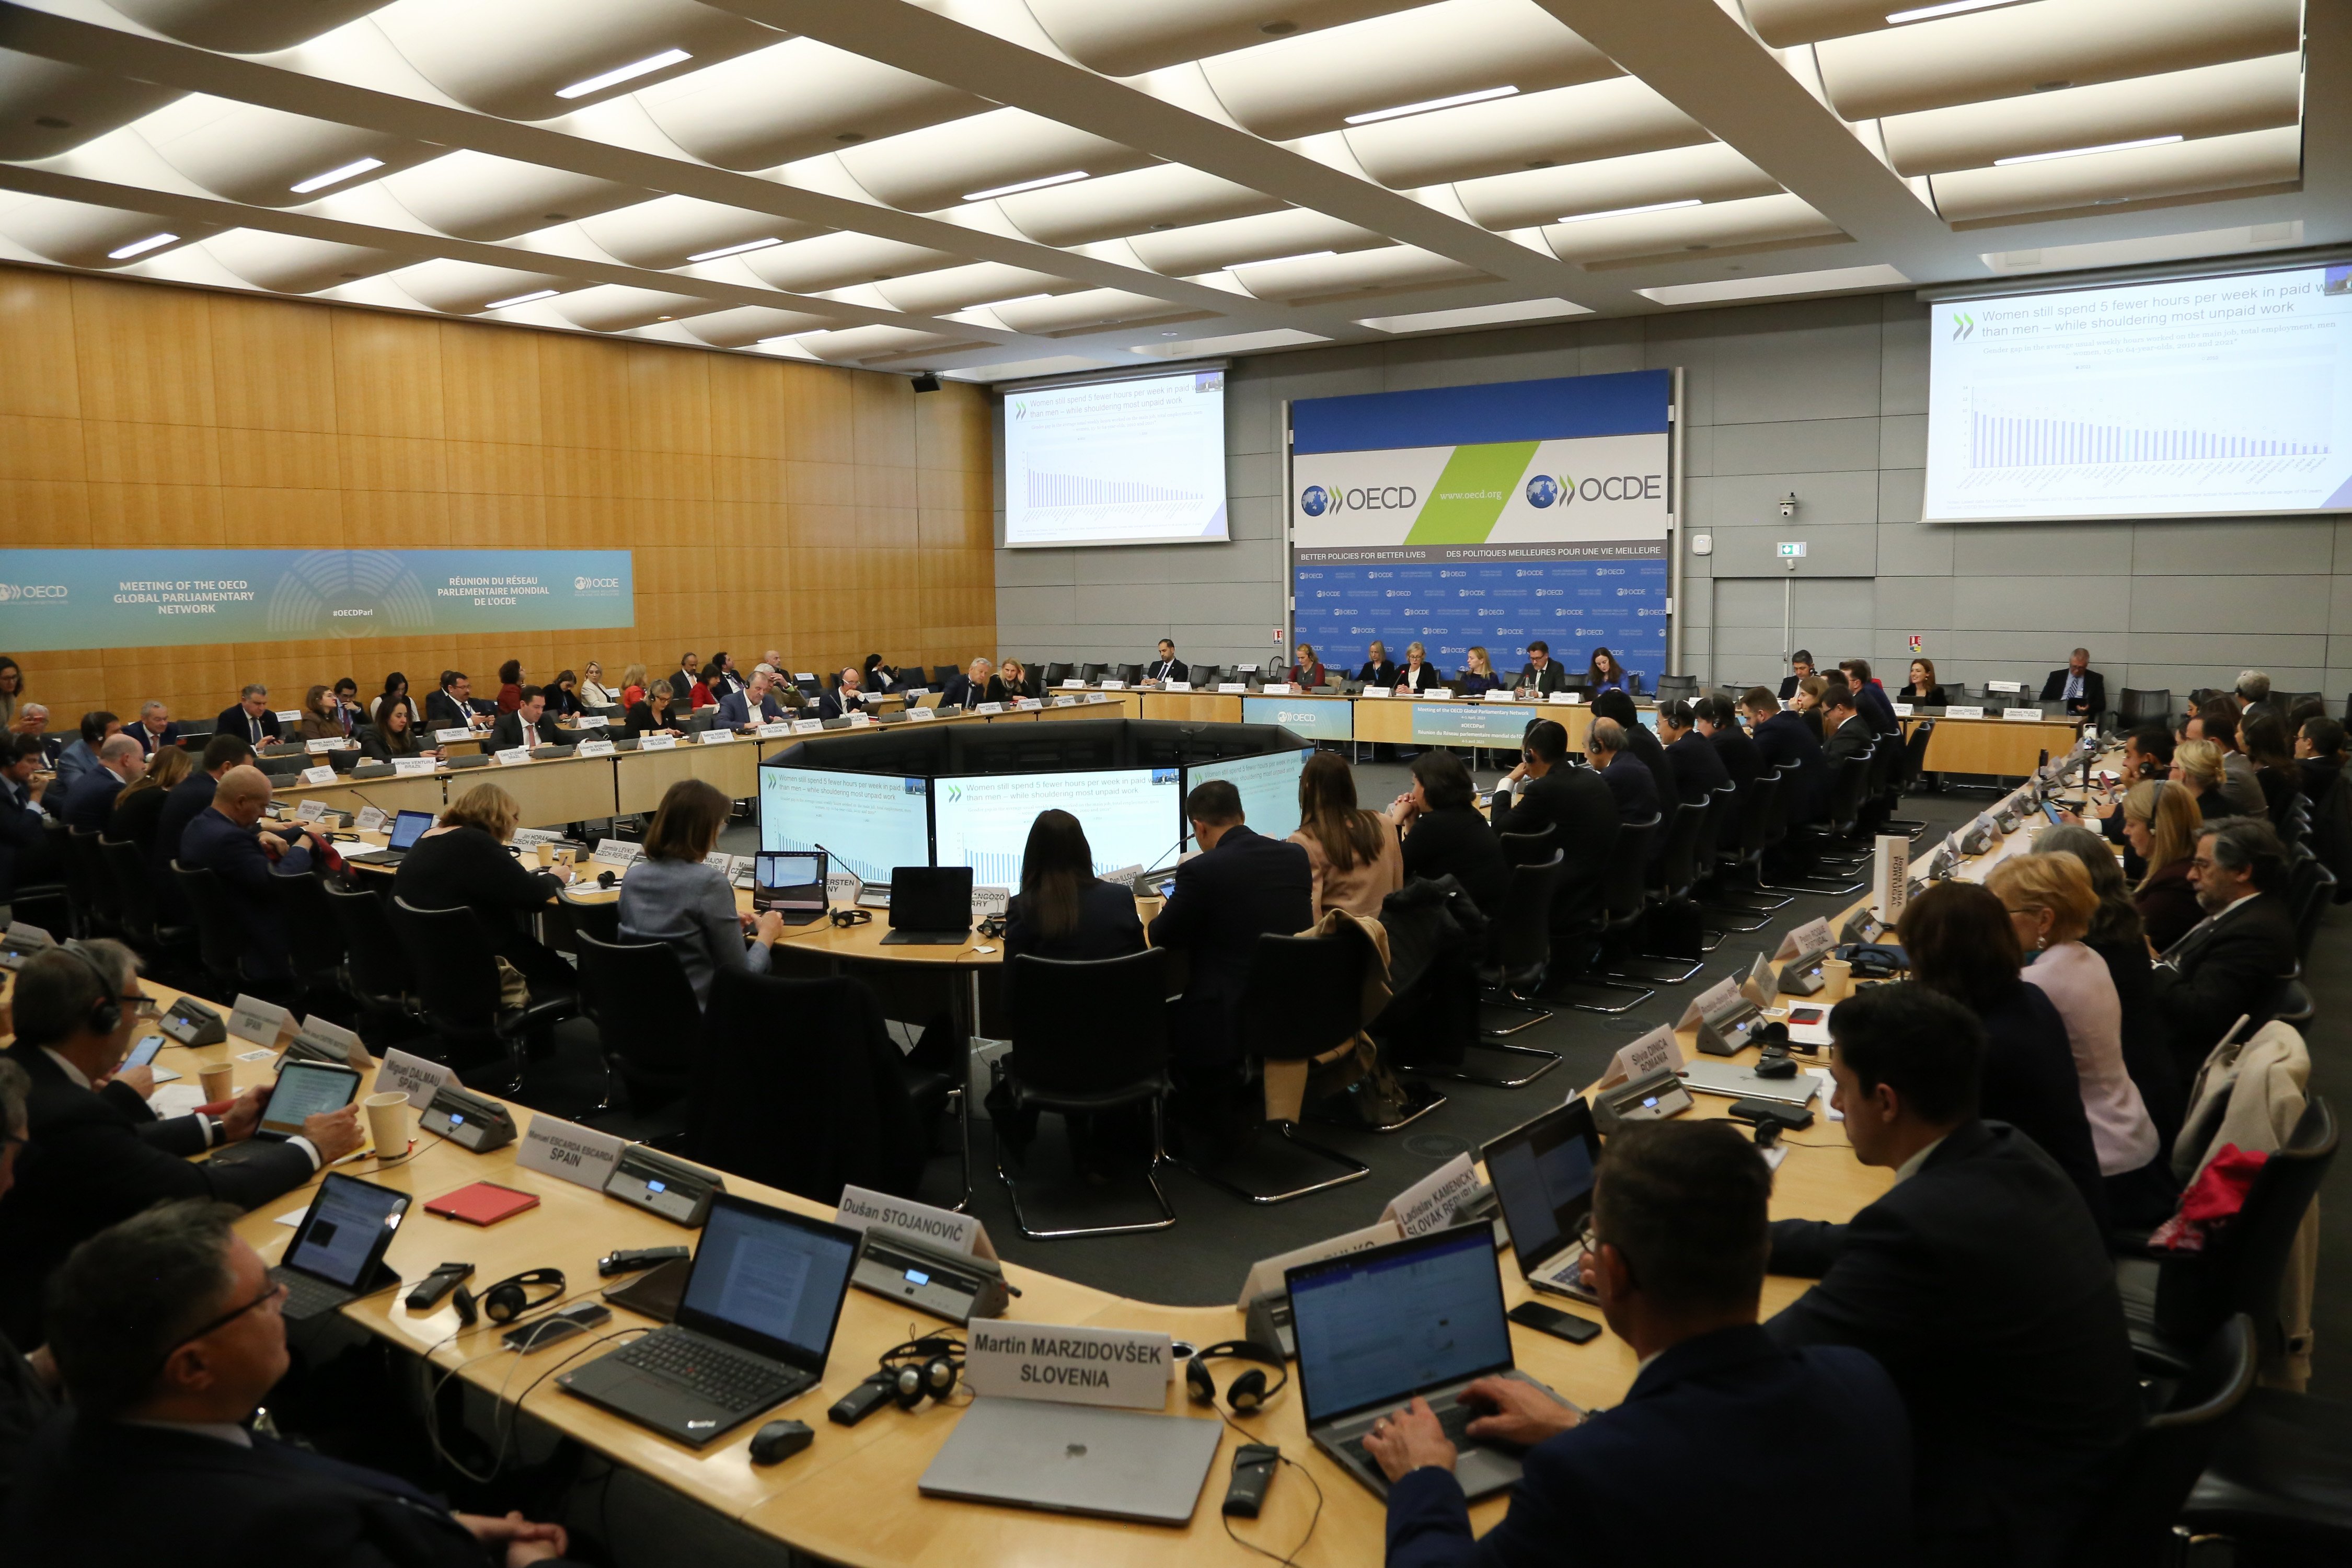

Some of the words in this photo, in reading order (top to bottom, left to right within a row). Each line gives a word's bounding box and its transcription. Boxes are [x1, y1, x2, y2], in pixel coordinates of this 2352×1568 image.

[1982, 311, 2028, 321] Women
[2033, 306, 2053, 317] still
[2058, 303, 2095, 316] spend
[2101, 302, 2107, 311] 5
[2113, 299, 2148, 310] fewer
[2153, 295, 2189, 306] hours
[2195, 293, 2217, 306] per
[2222, 288, 2258, 300] week
[2263, 287, 2274, 297] in
[2280, 283, 2310, 298] paid
[1982, 327, 2008, 337] than
[2013, 325, 2038, 335] men
[2055, 320, 2086, 331] while
[2092, 314, 2166, 328] shouldering
[2172, 310, 2204, 321] most
[2209, 305, 2255, 320] unpaid
[2261, 302, 2294, 313] work
[2047, 342, 2073, 351] average
[2262, 324, 2315, 333] employment,
[1030, 398, 1053, 407] Women
[1055, 396, 1065, 405] still
[1067, 394, 1086, 405] spend
[1094, 391, 1112, 400] fewer
[1114, 389, 1132, 398] hours
[1134, 390, 1145, 398] per
[1147, 386, 1165, 395] week
[1174, 384, 1189, 395] paid
[1067, 406, 1082, 414] while
[1084, 402, 1121, 414] shouldering
[1142, 398, 1163, 409] unpaid
[1166, 396, 1182, 405] work
[1347, 487, 1416, 510] OECD
[1440, 490, 1502, 501] www.oecd.org
[1580, 475, 1661, 501] OCDE
[120, 582, 173, 591] MEETING
[176, 581, 191, 590] OF
[194, 581, 215, 590] THE
[218, 580, 247, 589] OECD
[437, 588, 508, 596] PARLEMENTAIRE
[511, 586, 549, 595] MONDIAL
[449, 576, 489, 586] RÉUNION
[492, 577, 503, 585] DU
[506, 575, 537, 585] RÉSEAU
[593, 578, 618, 588] OCDE
[24, 586, 67, 598] OECD
[114, 593, 159, 603] GLOBAL
[163, 592, 254, 602] PARLIAMENTARY
[488, 597, 516, 605] L'OCDE
[158, 605, 215, 614] NETWORK
[387, 1059, 409, 1076] Miguel
[409, 1067, 442, 1087] DALMAU
[1641, 1052, 1668, 1073] ROMANIA
[398, 1077, 420, 1093] SPAIN
[550, 1137, 580, 1151] ESCARDA
[582, 1146, 614, 1162] ESCARDA
[550, 1148, 582, 1167] SPAIN
[843, 1197, 879, 1221] Dušan
[882, 1207, 964, 1242] STOJANOVIČ
[1400, 1201, 1433, 1226] Ladislav
[974, 1334, 1028, 1355] Martin
[1031, 1334, 1162, 1365] MARZIDOVŠEK
[1020, 1365, 1110, 1389] SLOVENIA
